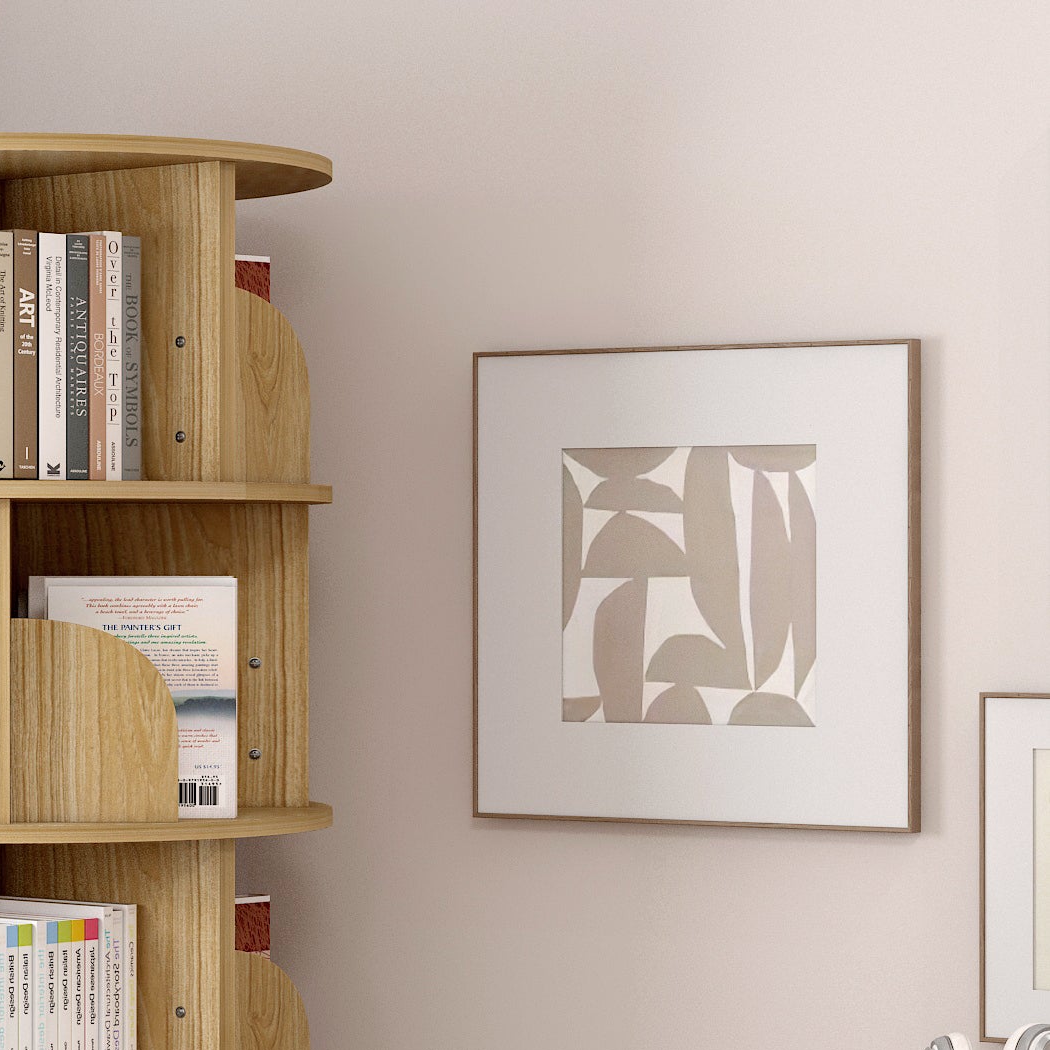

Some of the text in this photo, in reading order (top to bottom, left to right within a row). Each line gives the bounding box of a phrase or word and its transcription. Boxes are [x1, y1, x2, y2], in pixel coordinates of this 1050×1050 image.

[54, 256, 62, 276] Detail
[19, 288, 35, 328] ART
[54, 286, 62, 335] Contemporary
[108, 241, 118, 422] Over the Top
[125, 295, 139, 344] BOOK
[18, 348, 36, 356] Century
[54, 337, 62, 375] Residential
[73, 296, 87, 417] ANTIQUAIRES
[93, 333, 104, 397] BORDEAUX
[54, 376, 62, 418] Architecture
[125, 362, 139, 447] SYMBOLS
